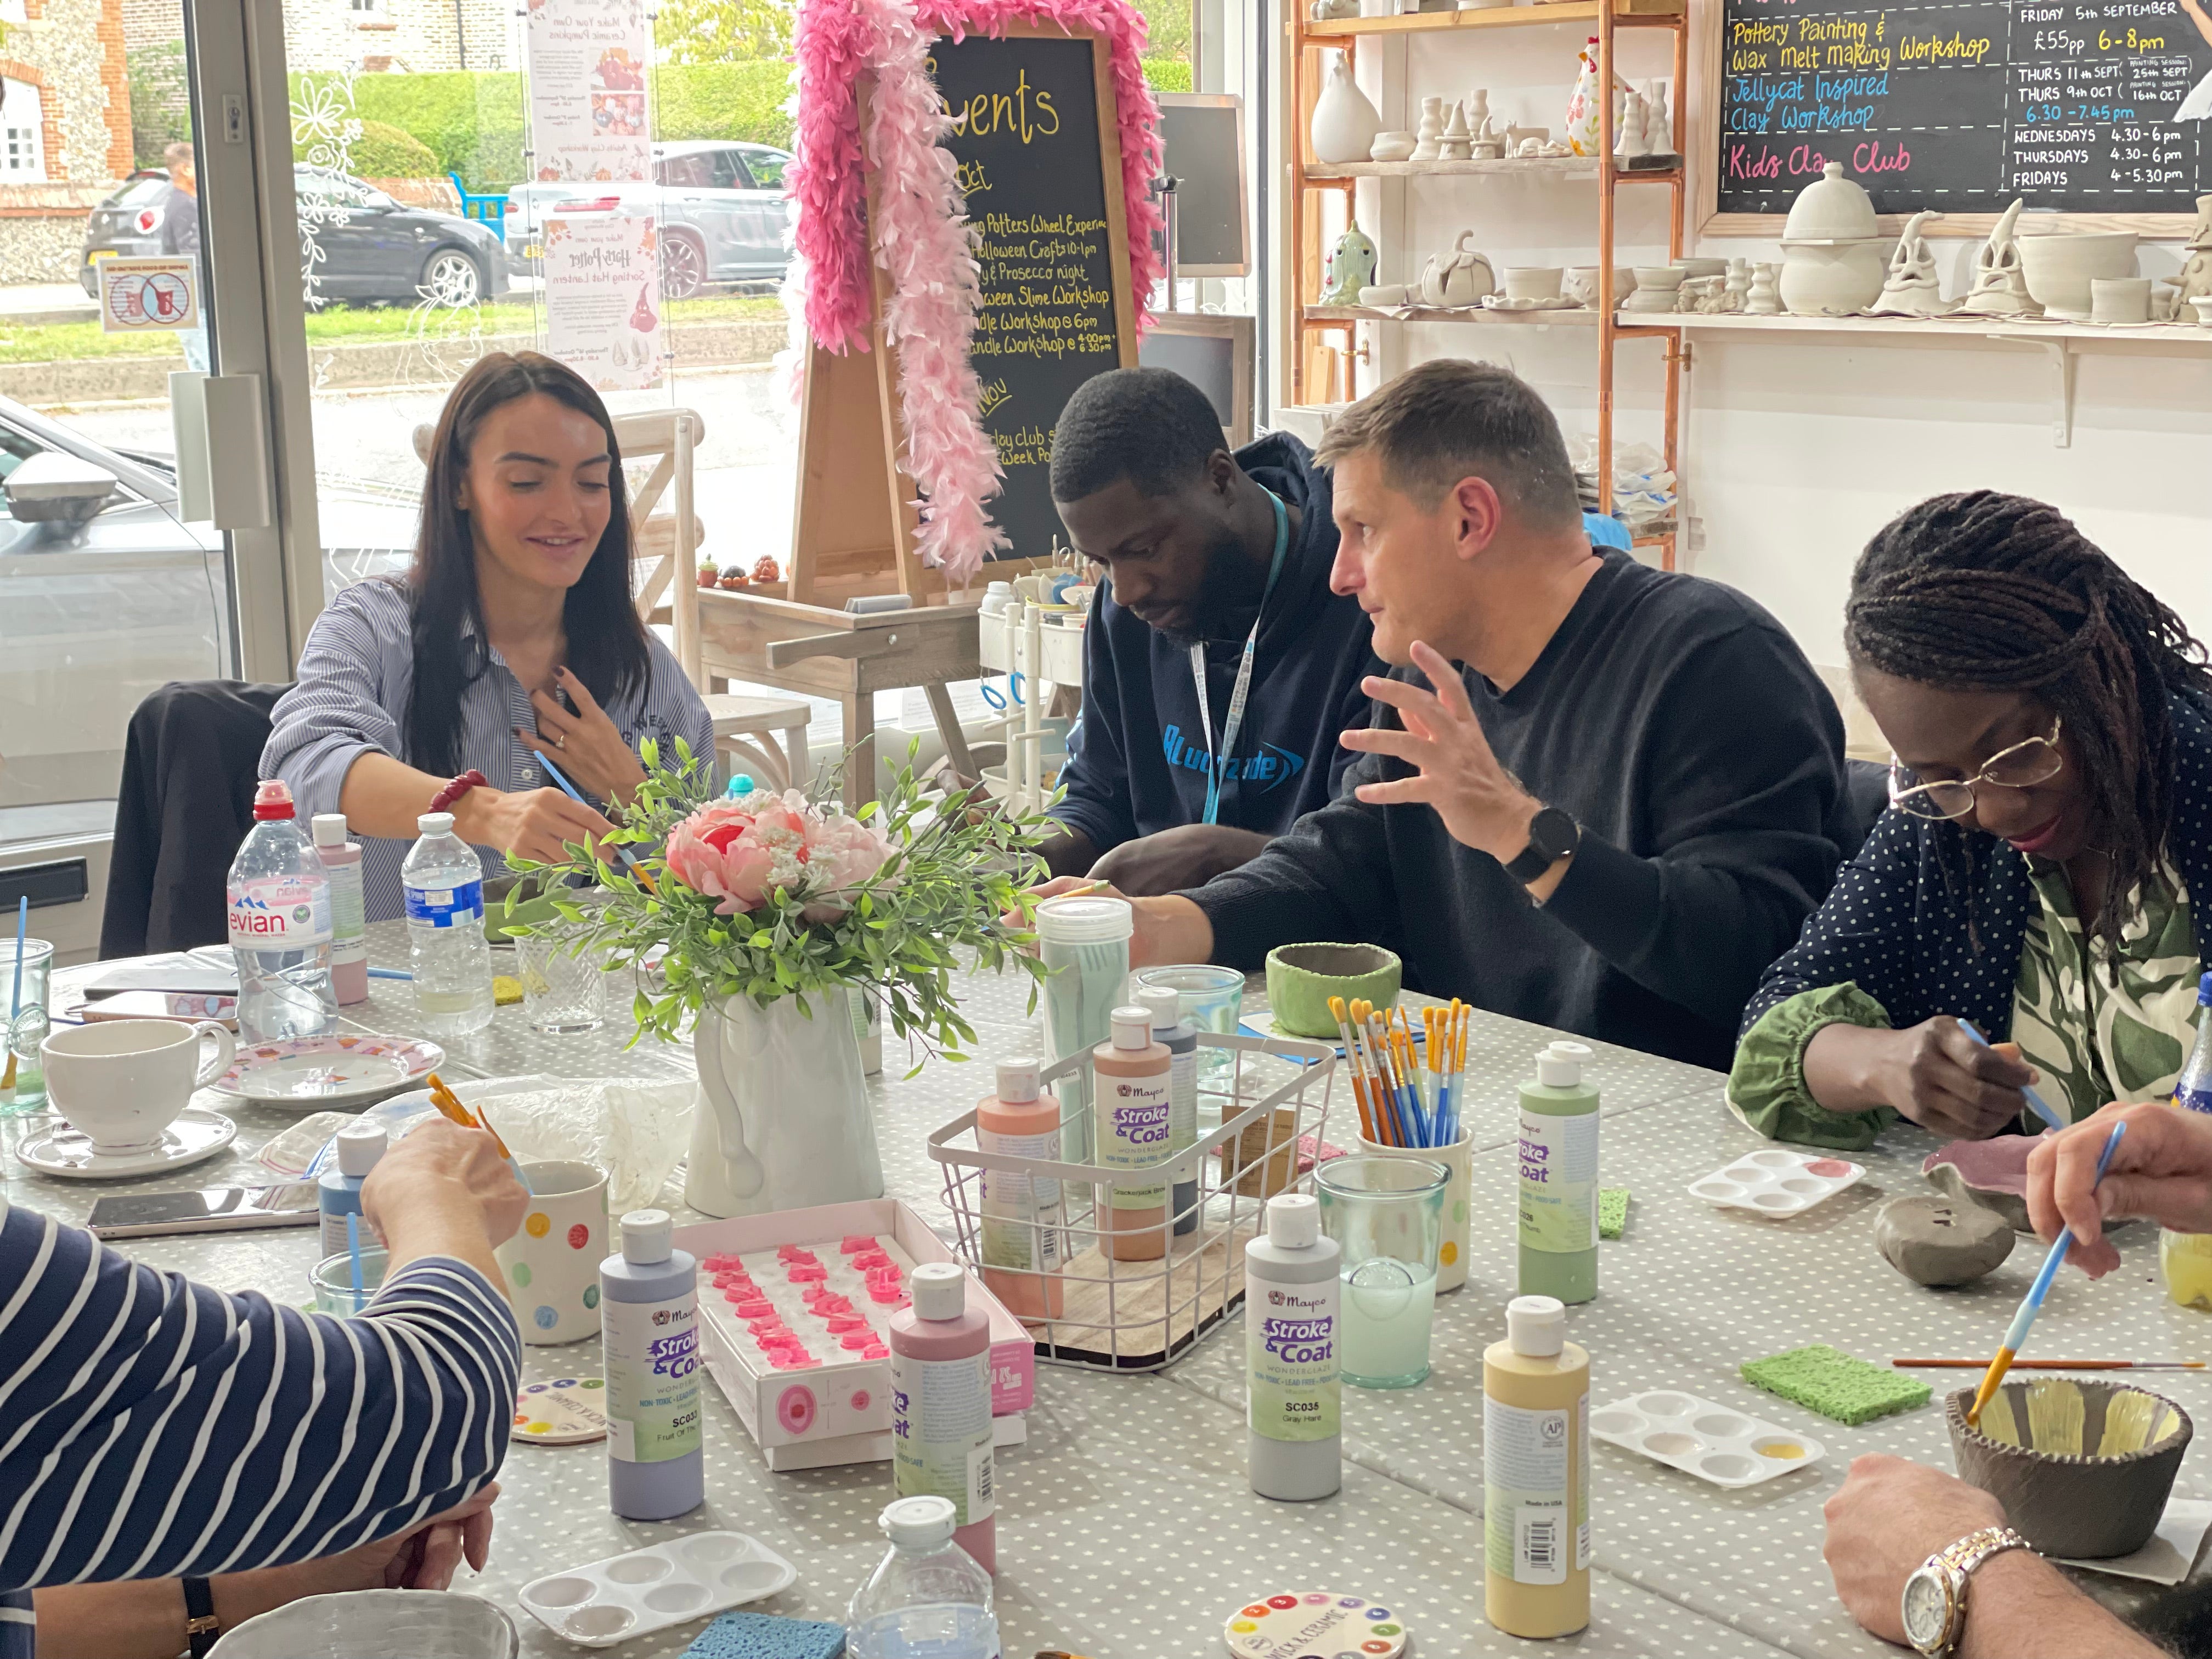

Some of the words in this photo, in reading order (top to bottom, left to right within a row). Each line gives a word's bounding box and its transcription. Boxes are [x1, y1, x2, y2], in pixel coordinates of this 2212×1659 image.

[2021, 7, 2063, 22] FRIDAY
[2075, 7, 2097, 20] 5th
[2103, 2, 2177, 17] SEPTEMBER
[1734, 21, 1788, 46] Pottery
[1798, 18, 1866, 46] Painting
[1875, 13, 1885, 42] &
[1733, 49, 1767, 70] Wax
[1900, 31, 1989, 63] Workshop
[2034, 30, 2084, 55] £55pp
[2018, 67, 2061, 82] THURS
[2133, 68, 2159, 78] 25th
[1733, 76, 1804, 111] Jellycat
[1815, 72, 1889, 109] Inspired
[2018, 87, 2059, 102] THURS
[2066, 86, 2087, 97] 9th
[2090, 86, 2112, 97] OCT
[2133, 90, 2157, 100] 16th
[2160, 89, 2181, 101] OCT
[1731, 108, 1770, 132] Clay
[1782, 104, 1874, 129] Workshop
[2015, 129, 2096, 143] WEDNESDAYS
[1730, 144, 1782, 179] Kids
[1788, 145, 1834, 175] Cla
[1853, 141, 1910, 173] Club
[2014, 150, 2089, 164] THURSDAYS
[956, 160, 992, 190] Oct
[2013, 171, 2068, 187] FRIDAYS
[986, 213, 1029, 237] Potters
[1031, 214, 1065, 233] Wheel
[1029, 238, 1065, 264] Crafts
[999, 262, 1053, 280] Prosecco
[1057, 263, 1088, 286] night
[983, 292, 1016, 306] ween
[1018, 286, 1050, 307] Slime
[1052, 285, 1109, 309] Workshop
[979, 312, 997, 335] dle
[1001, 311, 1061, 337] Workshop
[1074, 313, 1098, 330] 6pm
[969, 336, 1002, 356] andle
[1004, 334, 1065, 360] Workshop
[990, 428, 1013, 452] lay
[1015, 425, 1045, 447] club
[230, 911, 285, 933] evian
[1133, 1087, 1164, 1101] Mayco
[1119, 1107, 1167, 1124] Stroke
[1116, 1124, 1128, 1137] &
[1129, 1123, 1170, 1144] Coat
[1519, 1165, 1549, 1183] oat
[1287, 1296, 1327, 1313] Mayco
[1270, 1321, 1329, 1340] Stroke
[1265, 1338, 1278, 1353] &
[1280, 1341, 1333, 1363] Coat
[653, 1359, 669, 1375] &
[670, 1354, 699, 1379] Coa
[1267, 1364, 1331, 1375] WONDERGLAZE
[1285, 1378, 1301, 1387] LEAD
[1301, 1378, 1316, 1386] FREE
[676, 1392, 690, 1403] LEAD
[1285, 1402, 1319, 1412] SC035
[673, 1409, 698, 1428] SC033
[1283, 1414, 1301, 1424] Gray
[1304, 1413, 1322, 1422] Hare
[1548, 1422, 1562, 1434] AP
[657, 1432, 675, 1443] Fruit
